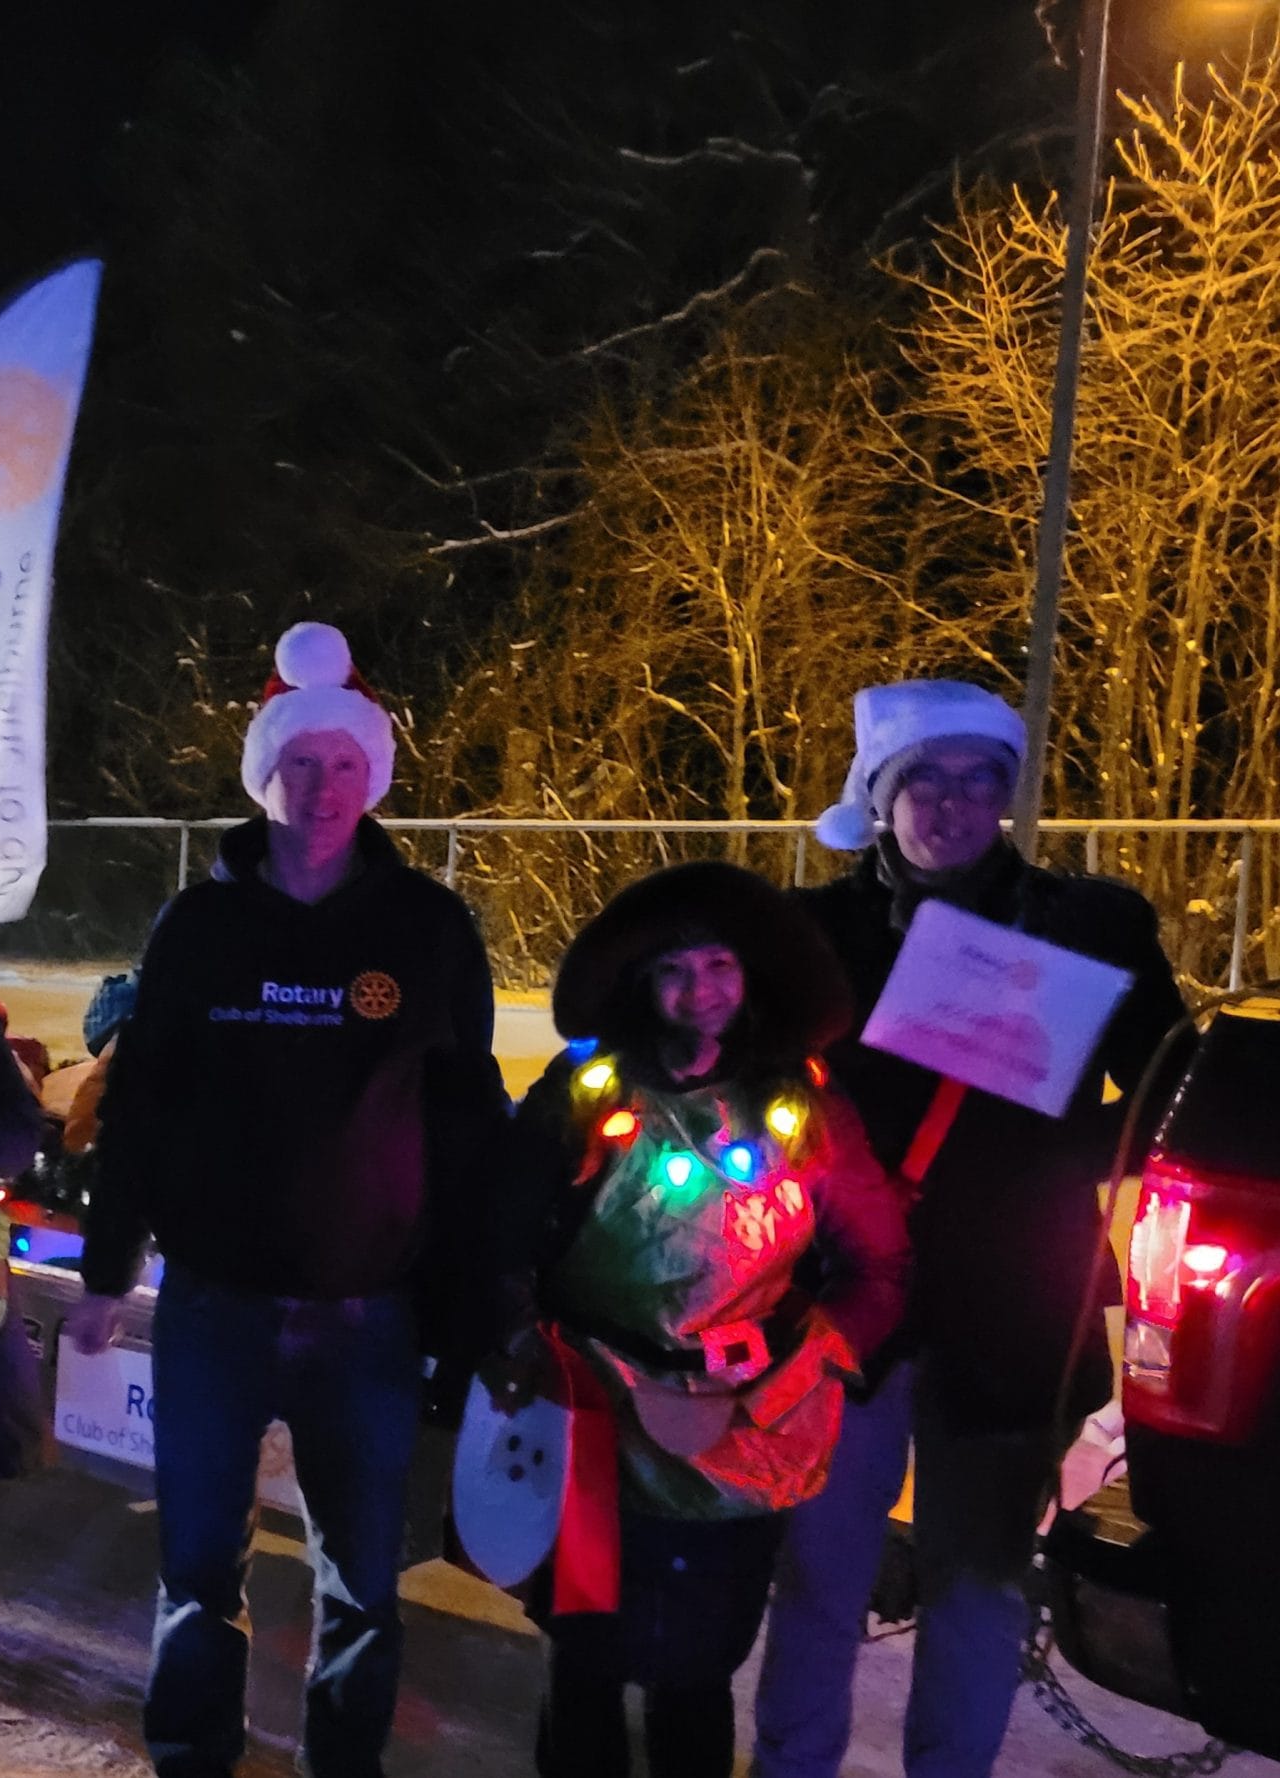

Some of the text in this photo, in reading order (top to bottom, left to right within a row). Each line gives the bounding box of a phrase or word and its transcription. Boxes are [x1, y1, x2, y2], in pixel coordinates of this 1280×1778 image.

[262, 981, 344, 1008] Rotary
[62, 1413, 104, 1442] Club
[107, 1427, 127, 1448] of
